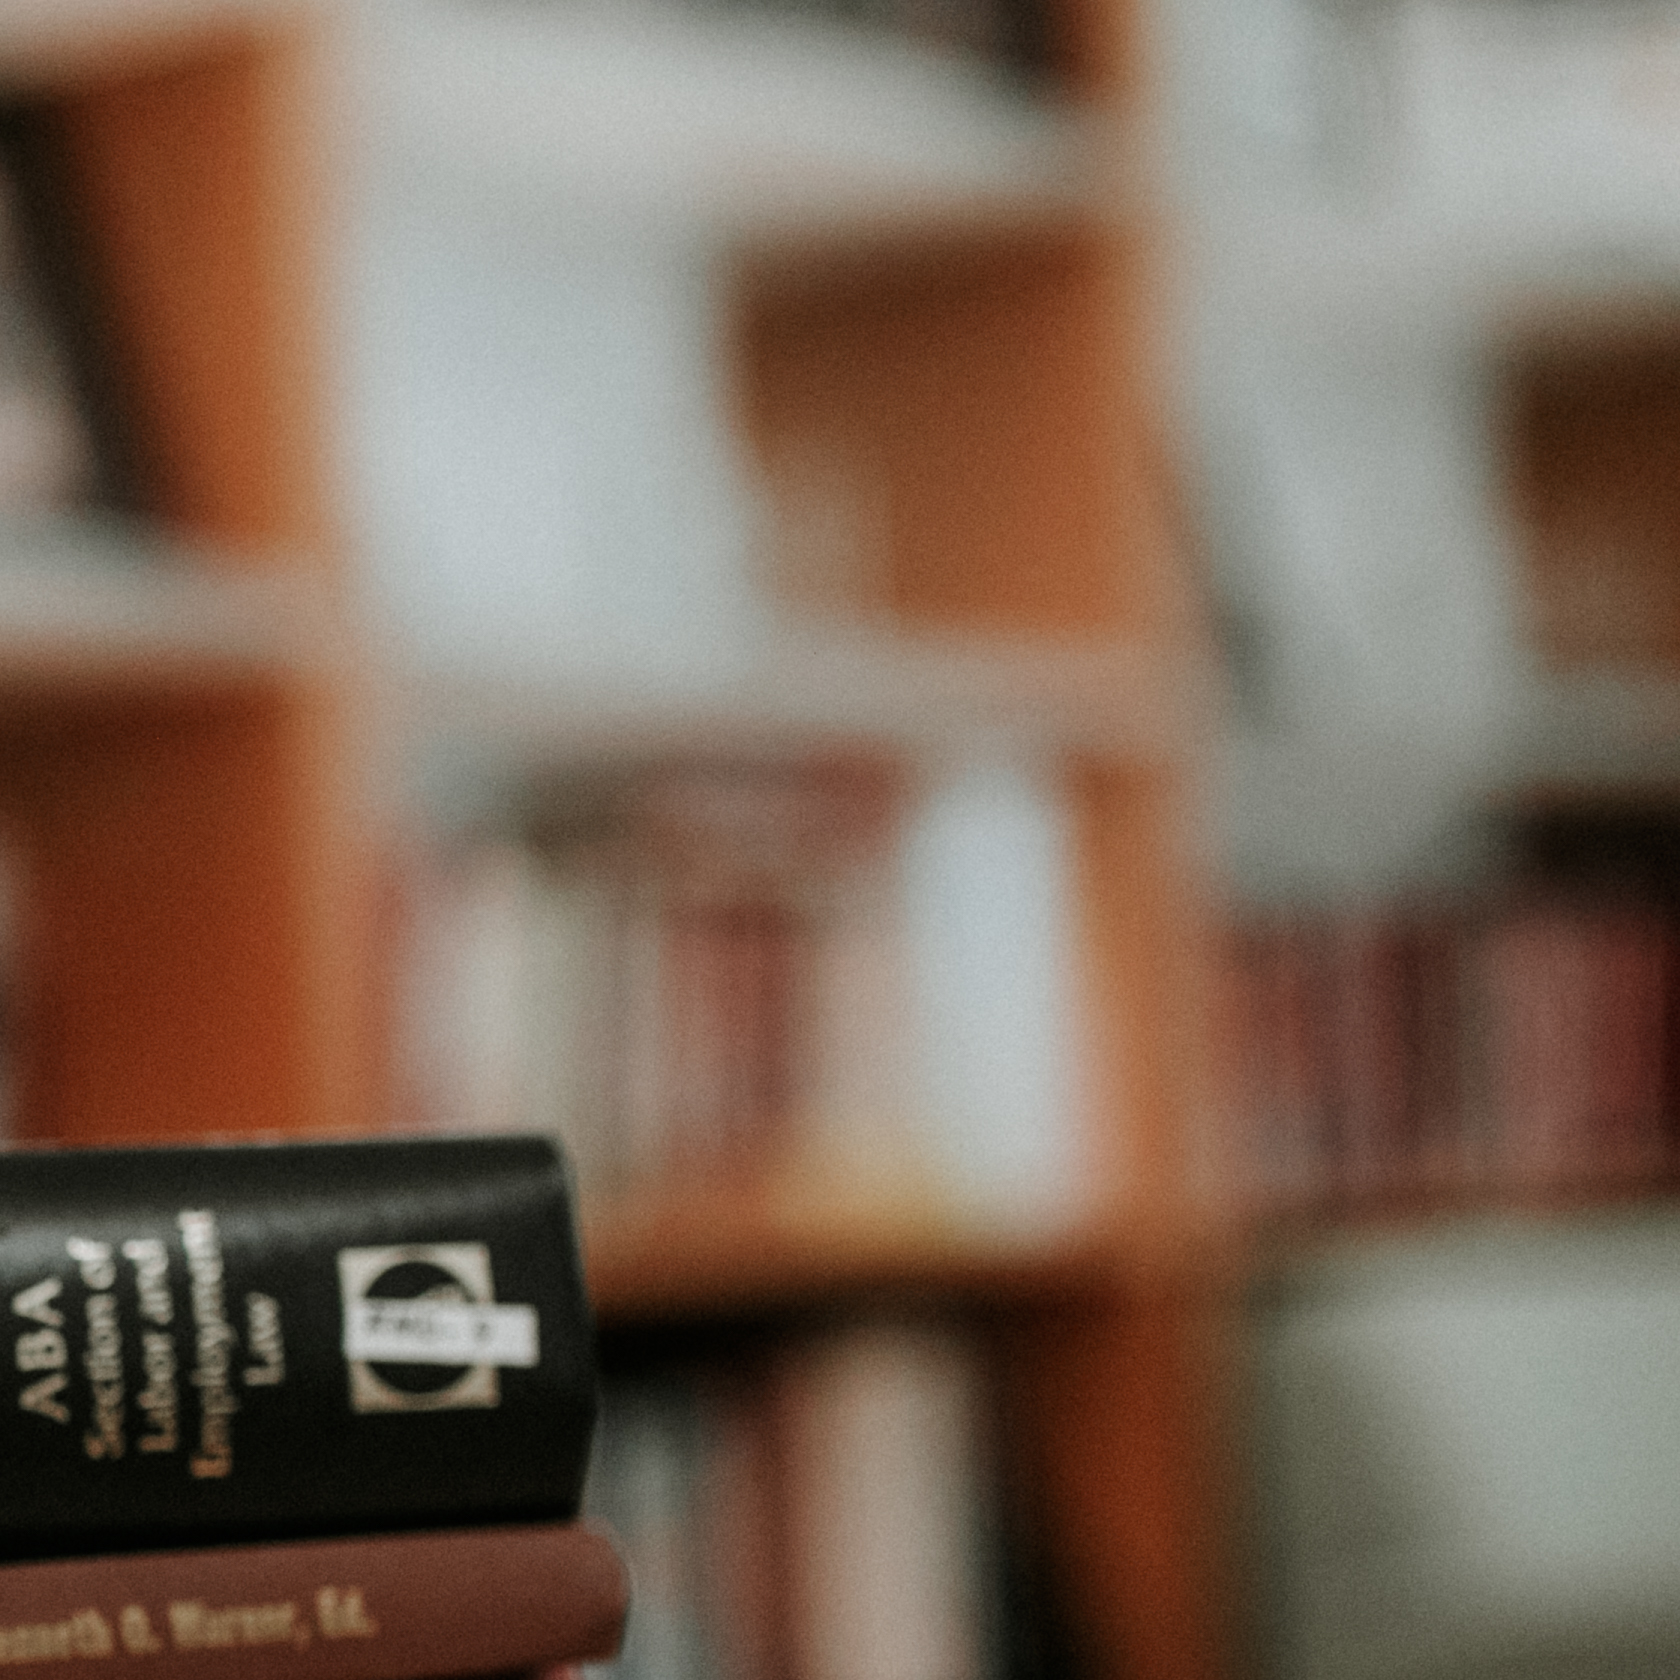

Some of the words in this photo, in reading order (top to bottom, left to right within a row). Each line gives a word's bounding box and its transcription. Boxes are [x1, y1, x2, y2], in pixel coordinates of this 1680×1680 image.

[65, 1236, 116, 1290] of
[121, 1236, 172, 1326] and
[10, 1275, 71, 1424] ABA
[83, 1294, 125, 1460] Section
[136, 1331, 179, 1454] Labor
[176, 1209, 237, 1478] Employment
[242, 1291, 286, 1388] Law
